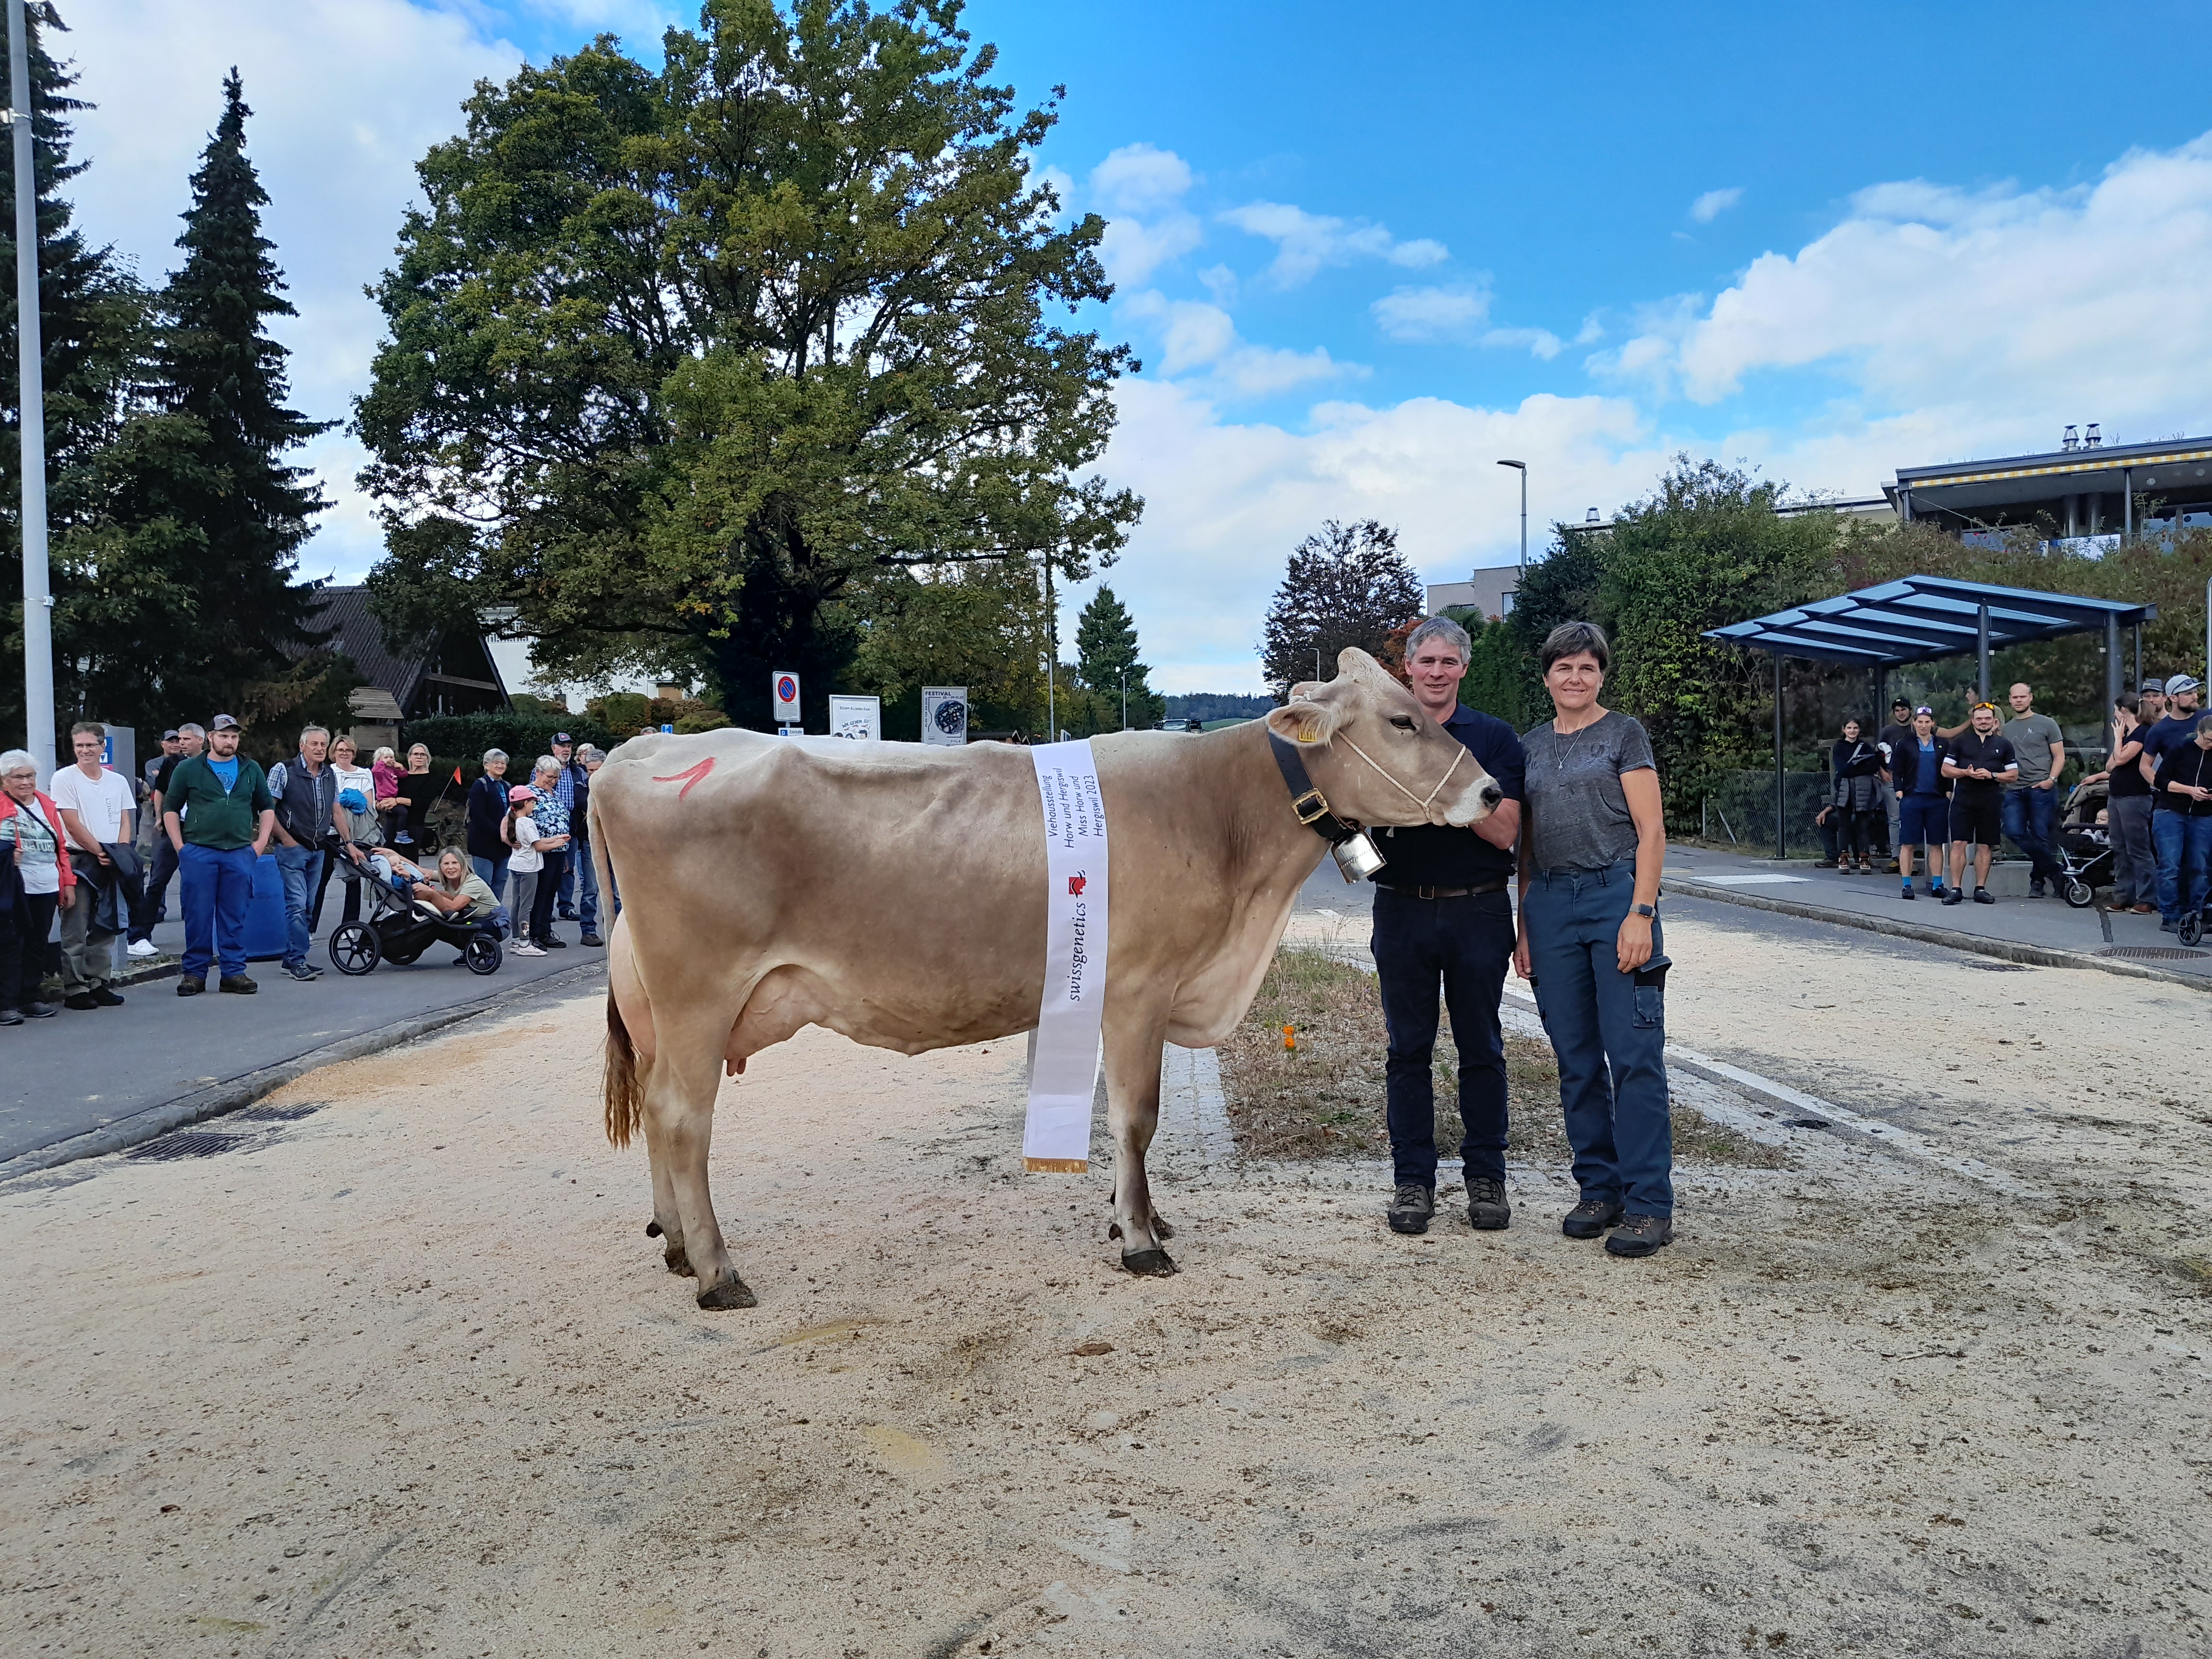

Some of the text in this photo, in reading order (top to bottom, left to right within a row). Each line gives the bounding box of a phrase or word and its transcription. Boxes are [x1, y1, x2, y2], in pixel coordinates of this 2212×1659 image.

[1042, 775, 1058, 837] Viehausstellung
[1052, 768, 1074, 848] Horw und Hergiswil
[1069, 775, 1089, 837] Miss Horw und
[1083, 775, 1105, 837] Hergiswil 2023
[1067, 902, 1087, 1001] swissgenetics
